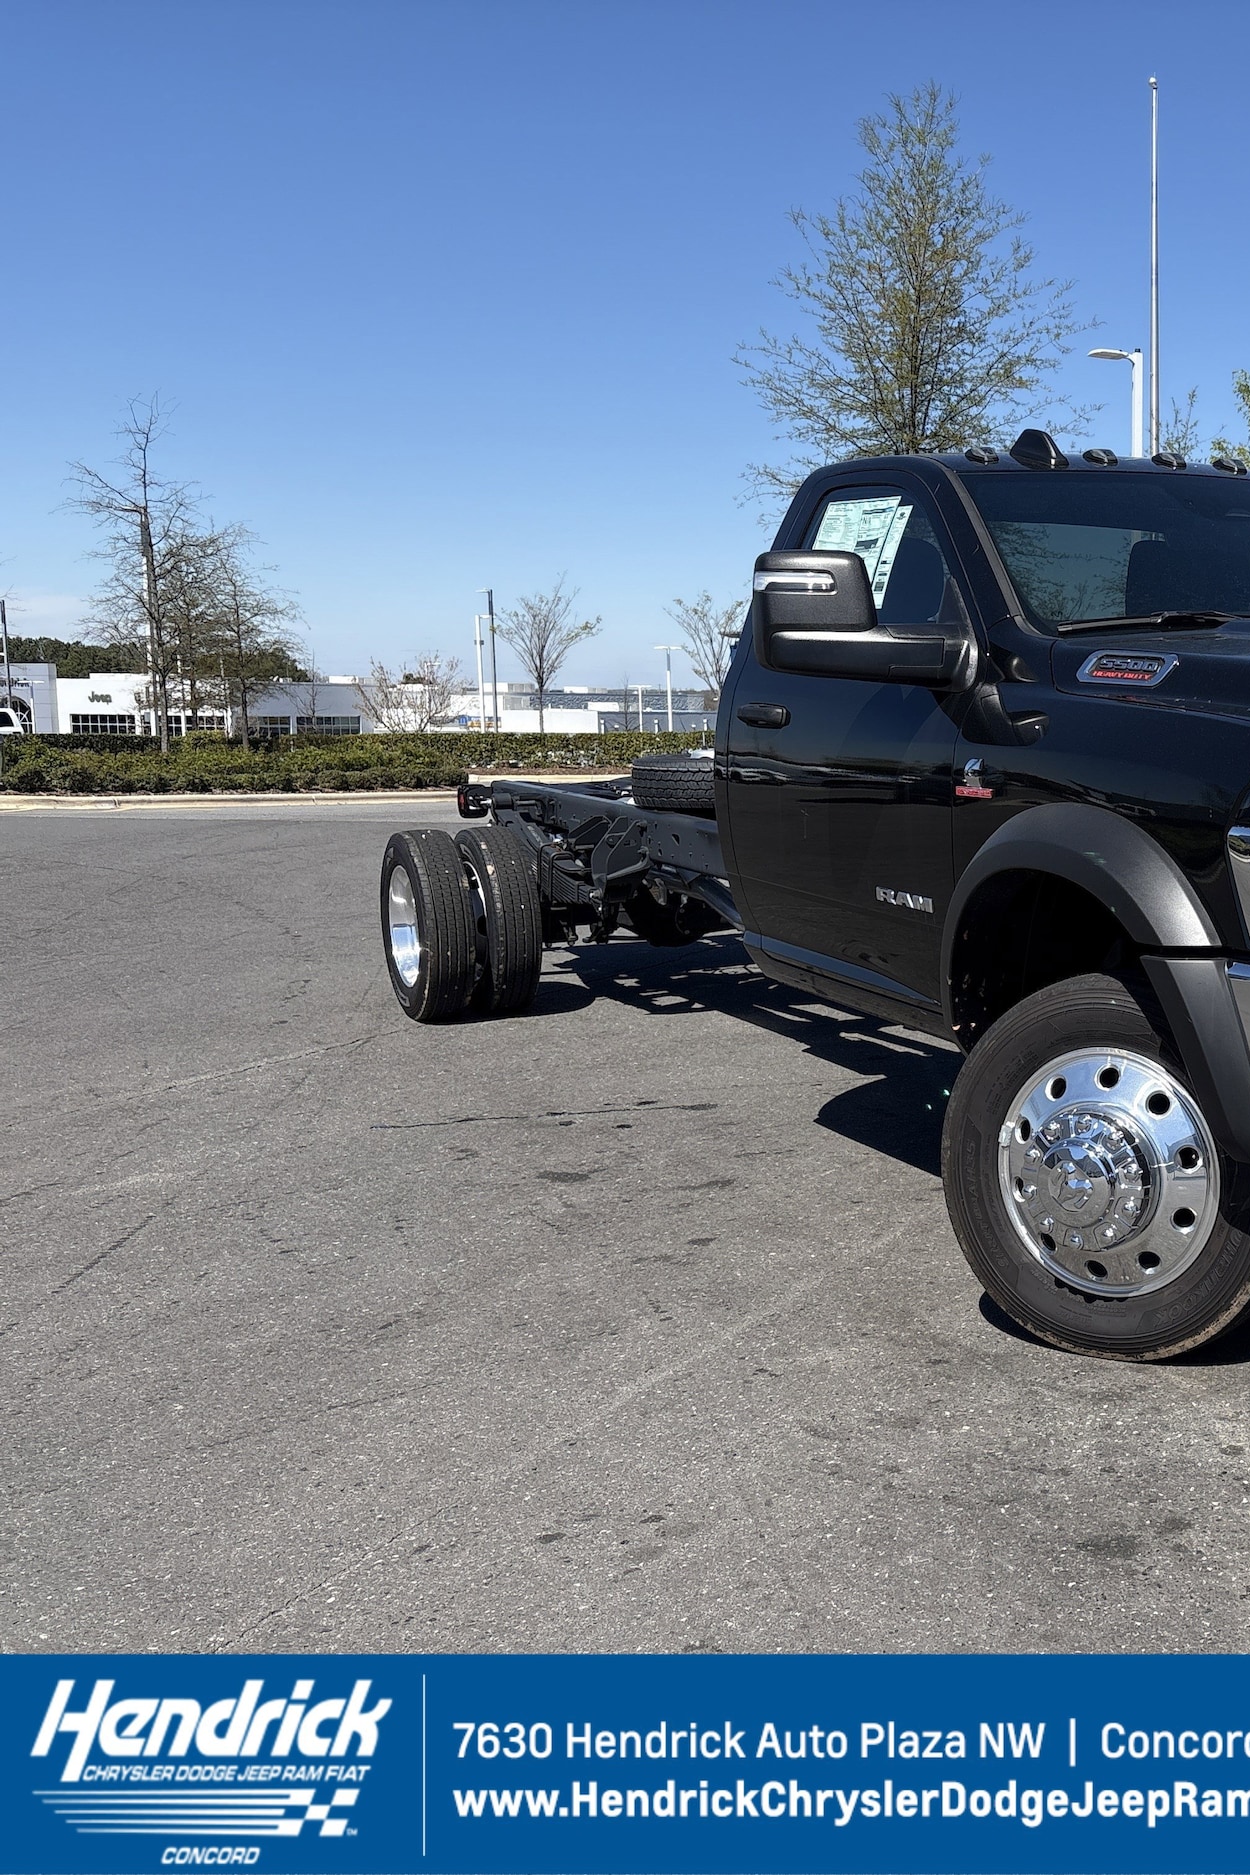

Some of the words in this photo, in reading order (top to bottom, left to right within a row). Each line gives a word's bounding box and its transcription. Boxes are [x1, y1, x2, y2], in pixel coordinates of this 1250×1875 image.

[1100, 658, 1158, 671] 5500
[88, 691, 112, 705] Jeep
[875, 886, 934, 914] RAM
